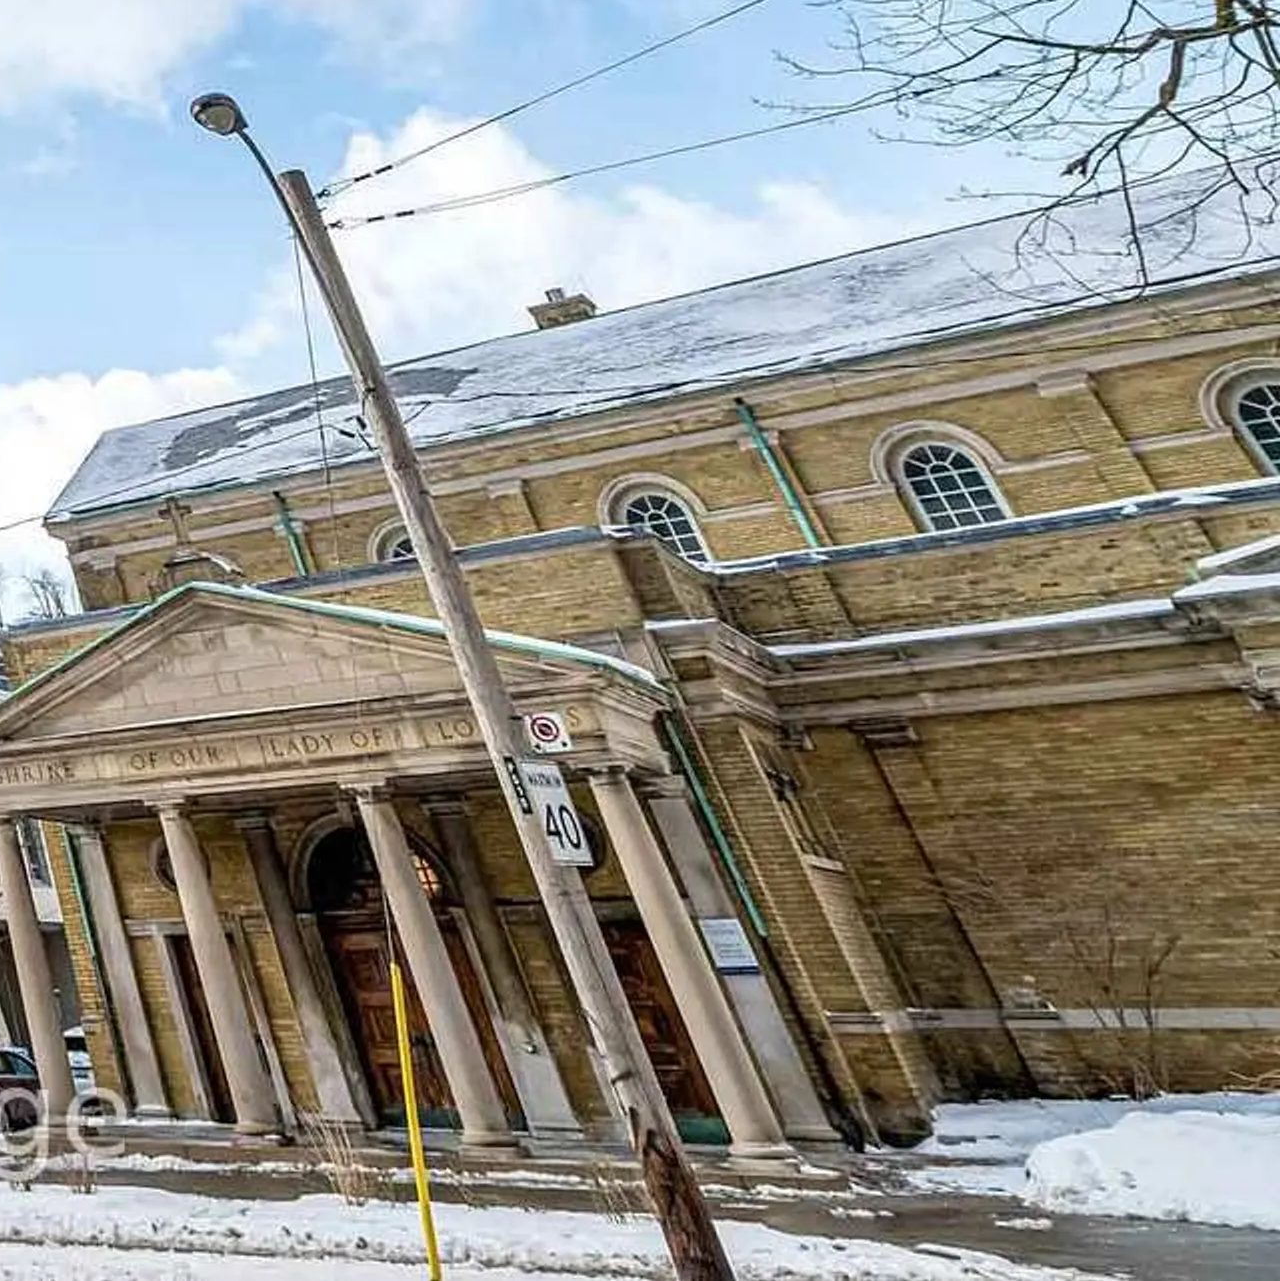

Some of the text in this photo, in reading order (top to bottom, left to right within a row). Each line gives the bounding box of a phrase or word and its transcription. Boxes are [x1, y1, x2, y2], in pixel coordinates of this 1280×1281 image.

[129, 751, 158, 771] OF
[169, 745, 222, 767] OUR
[269, 731, 336, 758] LADY
[349, 727, 384, 749] OF
[545, 803, 582, 850] 40
